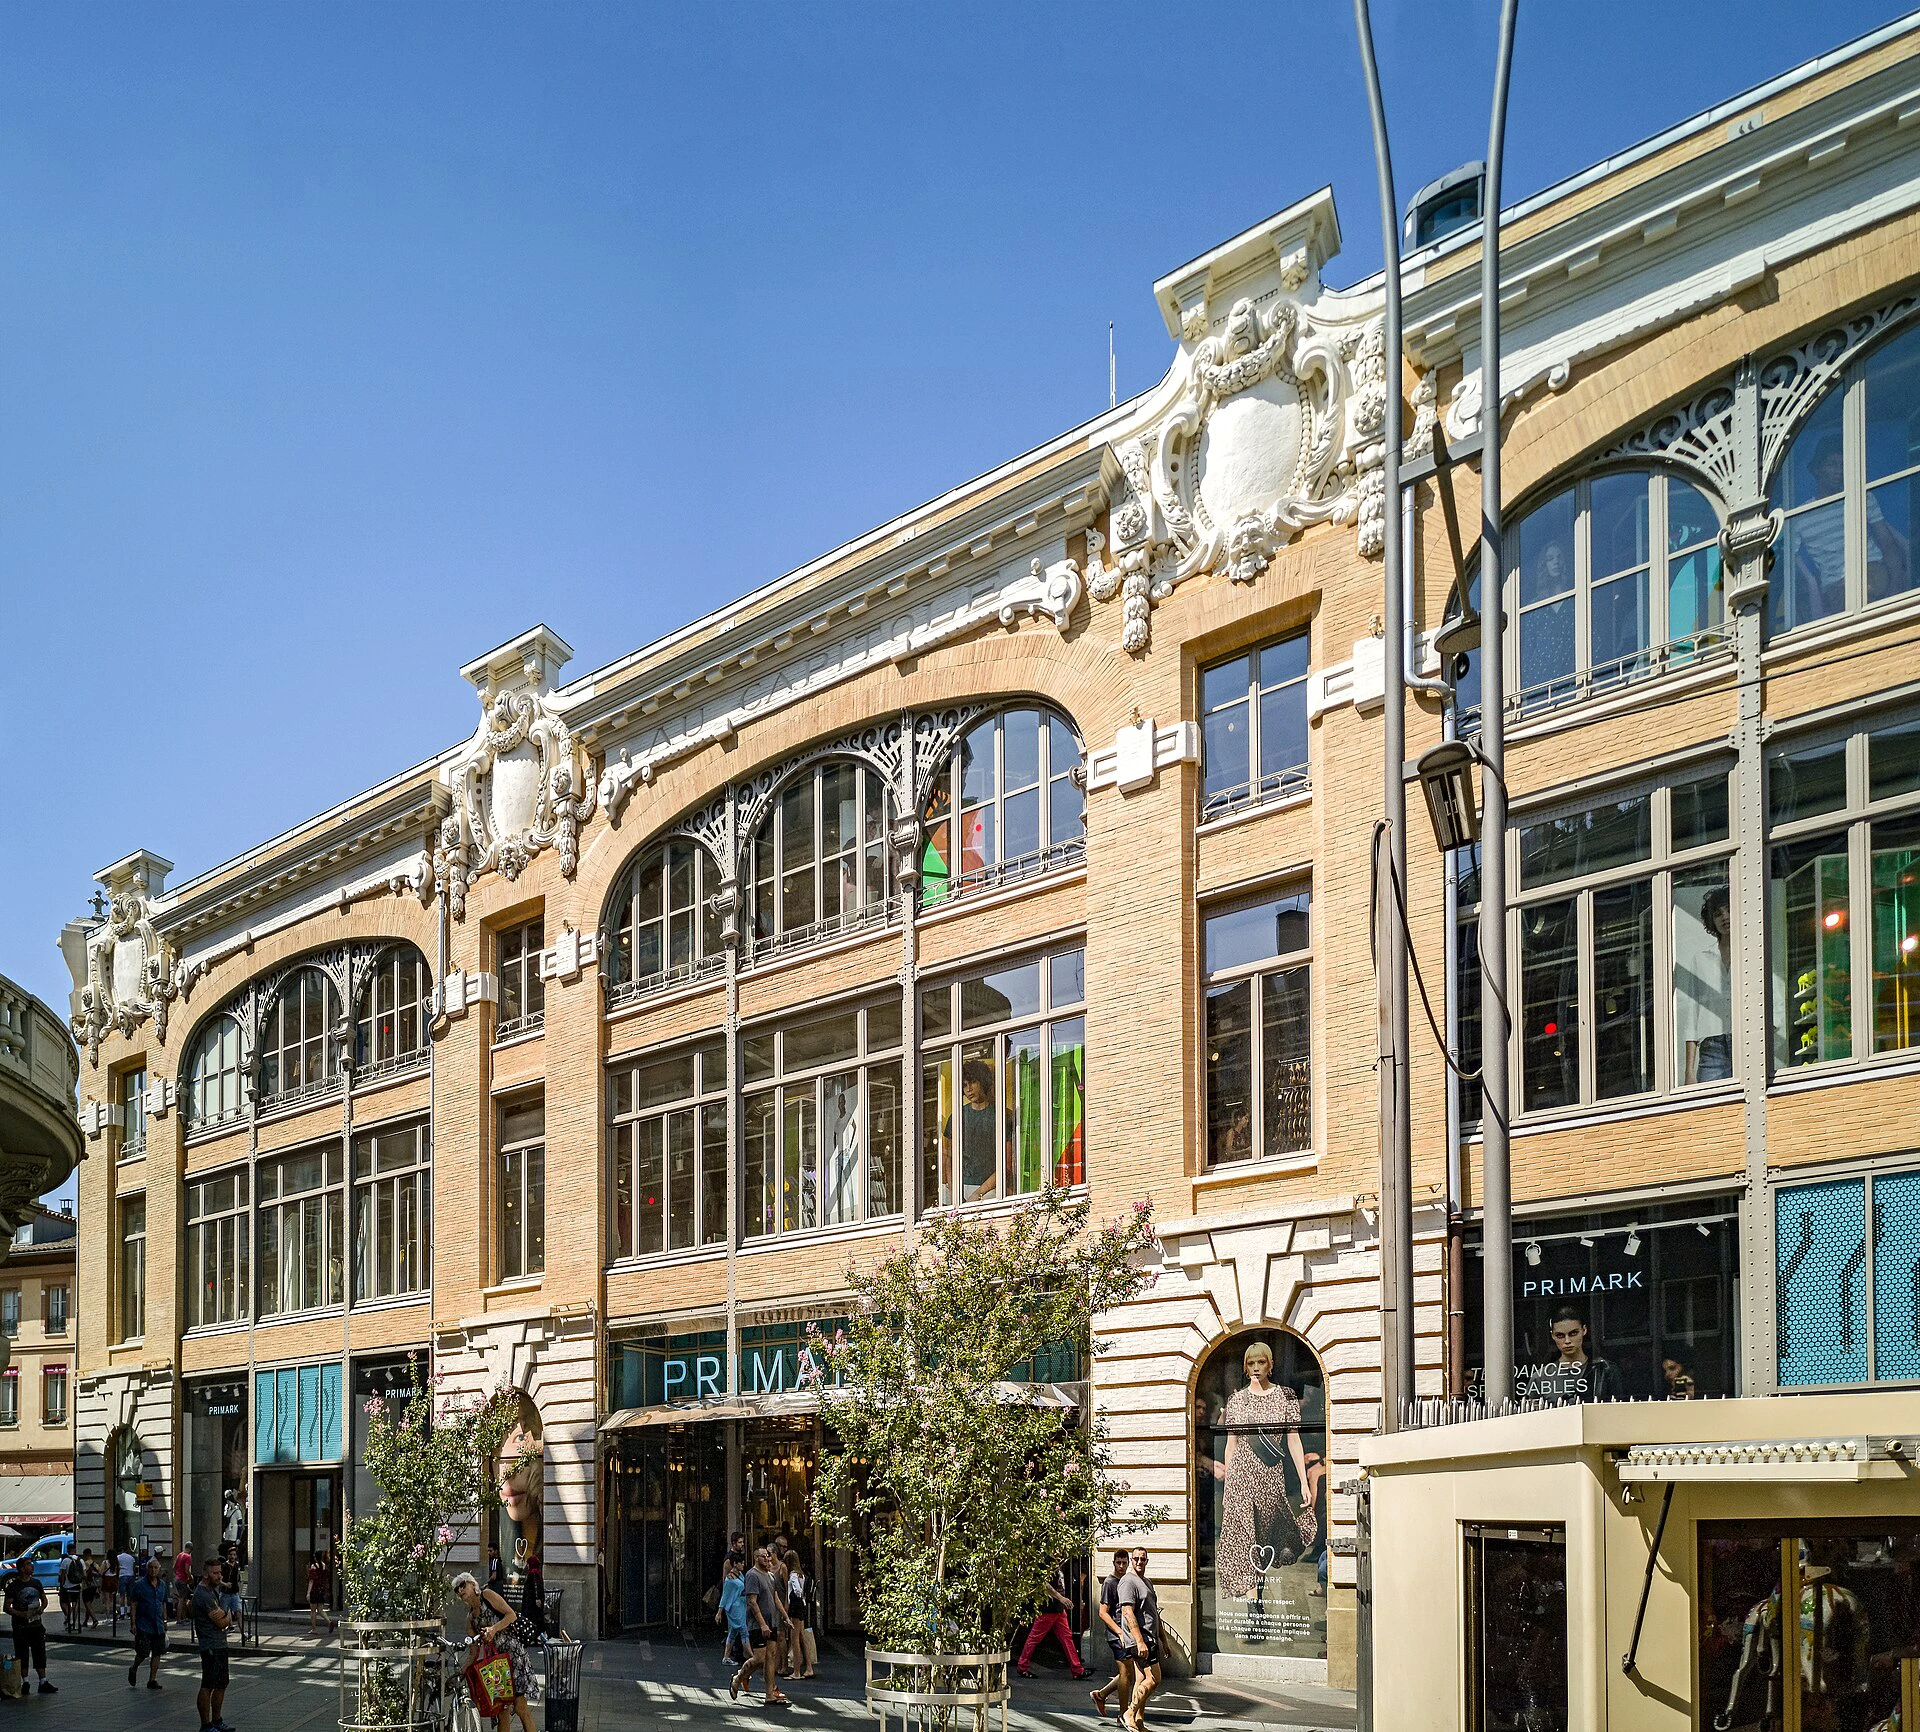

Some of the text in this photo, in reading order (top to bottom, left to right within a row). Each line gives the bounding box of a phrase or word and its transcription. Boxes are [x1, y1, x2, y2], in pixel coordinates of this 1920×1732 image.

[645, 570, 1002, 758] AU CAPITOLE
[1523, 1271, 1643, 1298] PRIMARK
[664, 1341, 898, 1402] PRIMA
[208, 1404, 239, 1415] PRIMARK
[1242, 1575, 1282, 1584] PRIMARK
